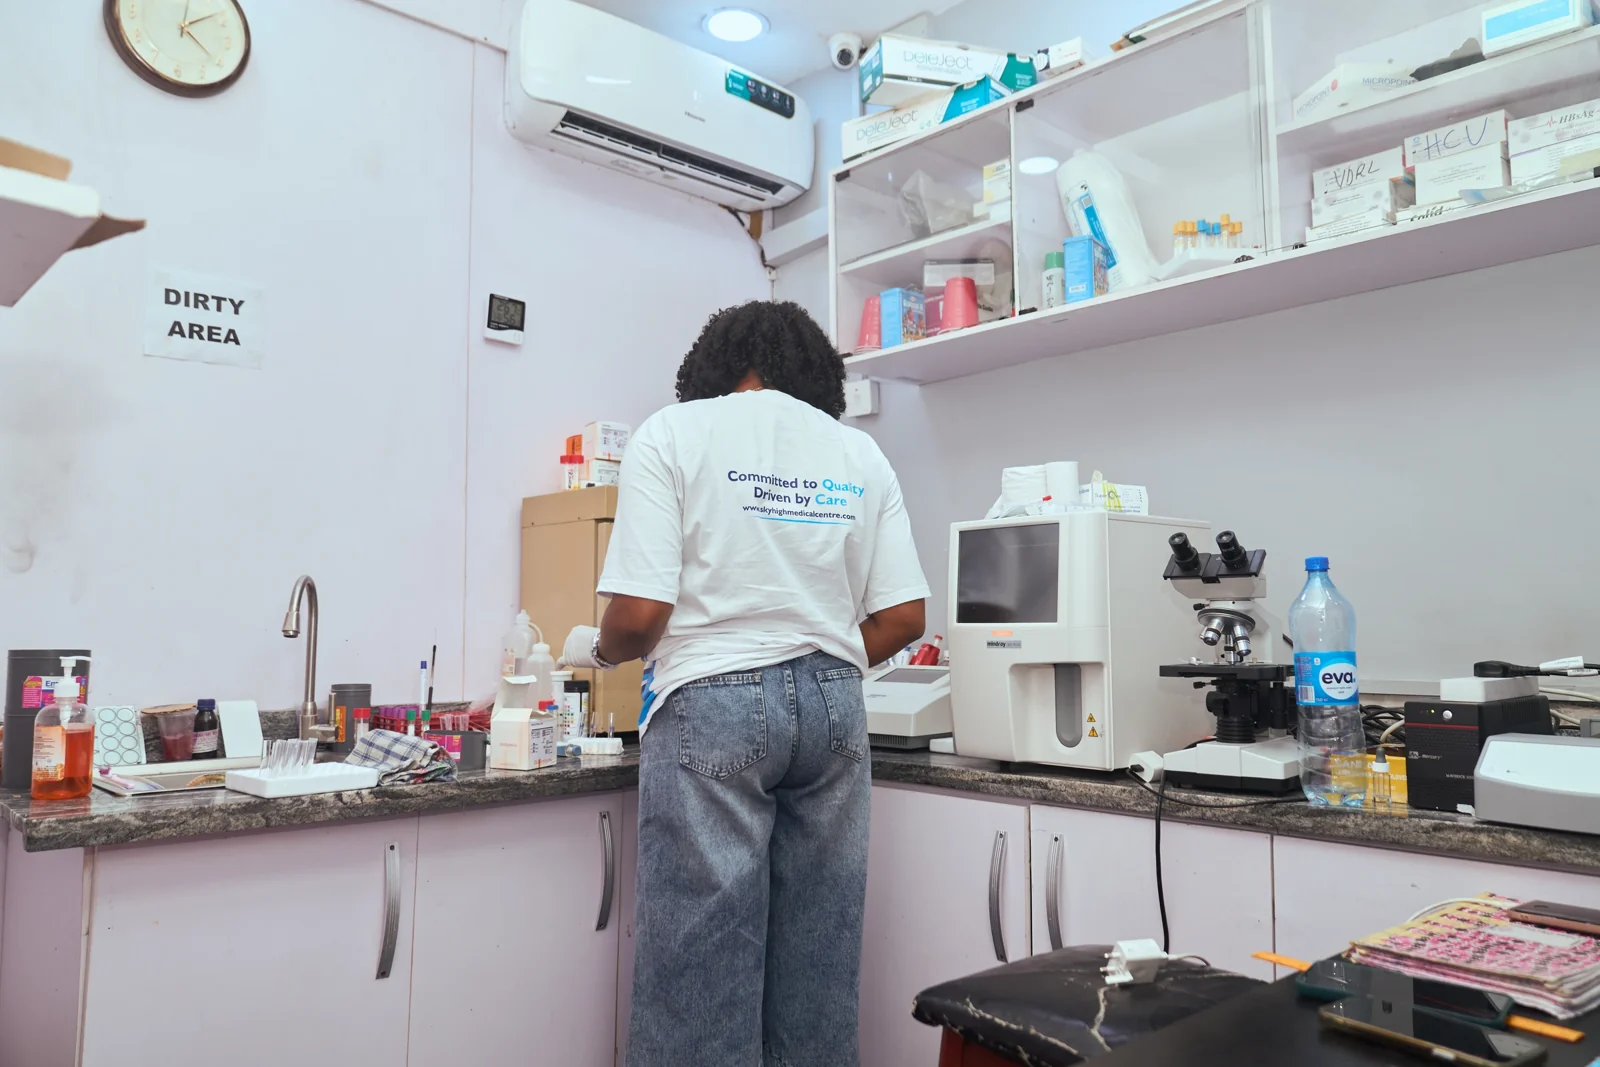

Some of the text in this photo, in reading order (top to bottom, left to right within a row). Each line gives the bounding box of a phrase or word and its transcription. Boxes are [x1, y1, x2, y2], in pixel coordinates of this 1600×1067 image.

[1333, 160, 1381, 189] VDRL
[164, 287, 245, 316] DIRTY
[167, 320, 241, 346] AREA
[727, 470, 865, 498] Committed to Quaity
[754, 486, 847, 507] Driven by Care
[742, 505, 856, 521] wwskyhighmedicalcentre.com
